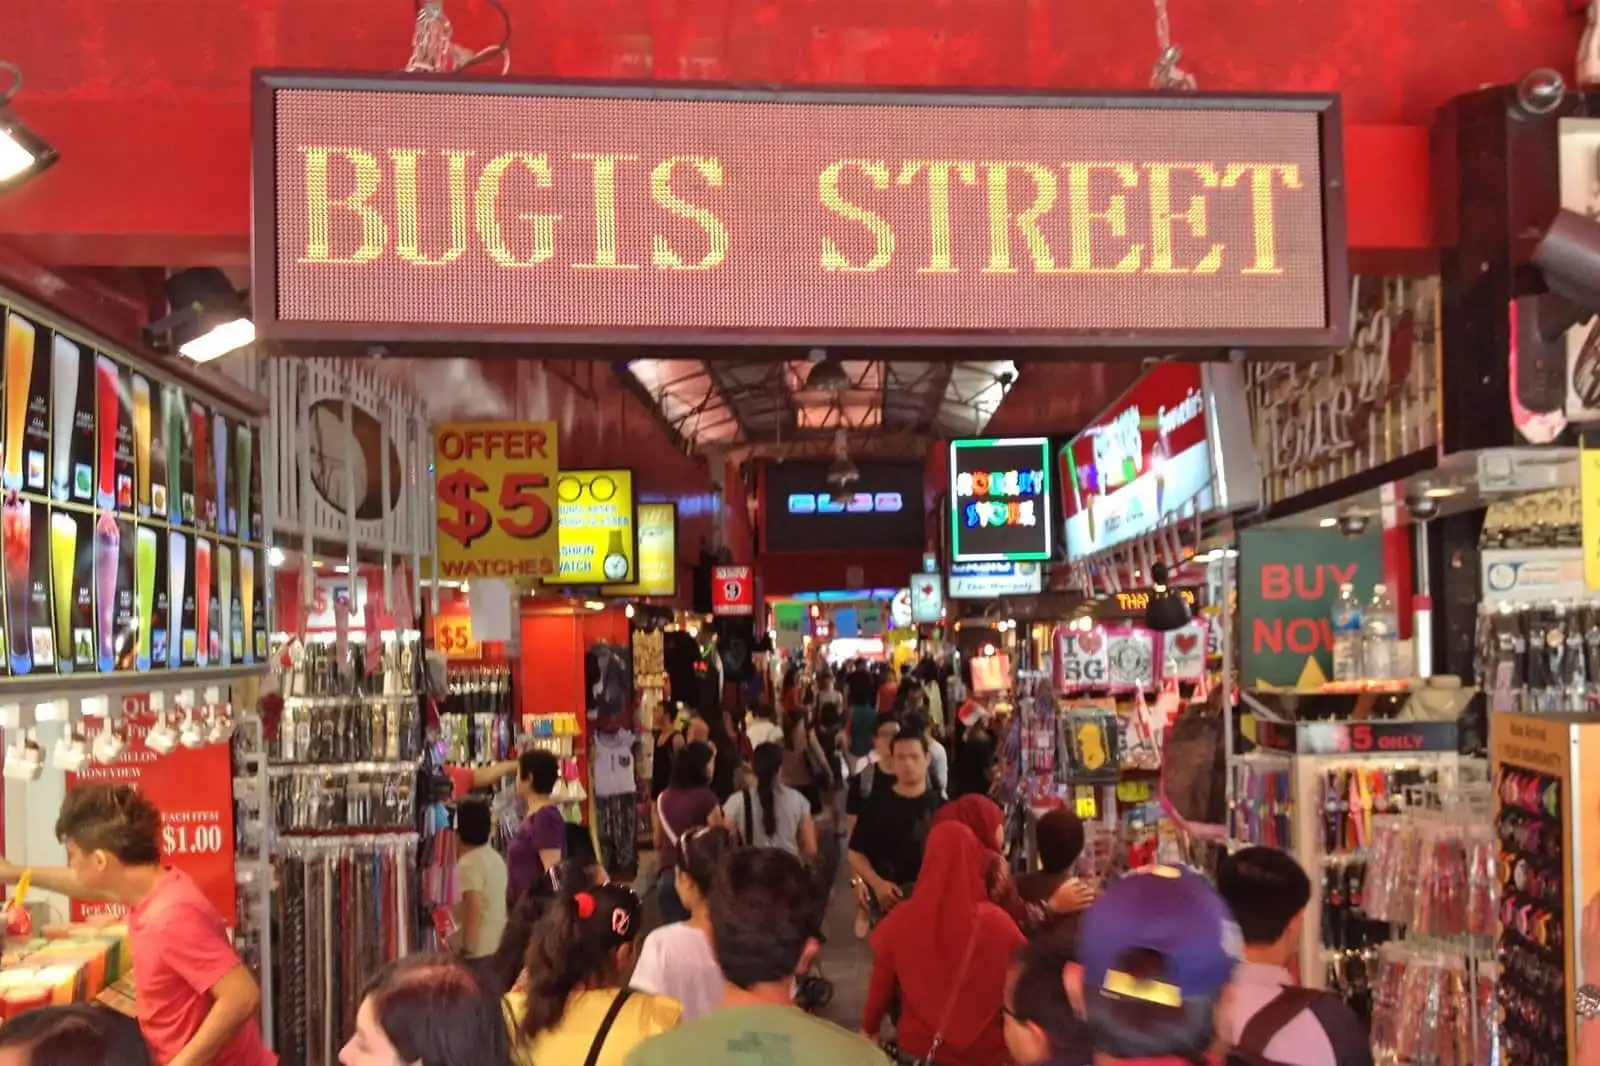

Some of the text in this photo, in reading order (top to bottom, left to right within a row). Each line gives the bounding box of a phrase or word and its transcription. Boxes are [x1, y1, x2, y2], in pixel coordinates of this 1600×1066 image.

[297, 146, 1303, 274] BUGIS STREET
[438, 429, 548, 461] OFFER
[436, 468, 552, 548] $5
[559, 545, 595, 557] SHION
[441, 557, 553, 577] WATCHES
[1260, 563, 1357, 600] BUY
[1116, 592, 1150, 610] THA
[439, 626, 468, 652] $5
[1064, 635, 1077, 657] I
[1064, 659, 1105, 681] SG
[1377, 735, 1425, 749] ONLY
[161, 811, 192, 822] EACH
[162, 825, 222, 856] $1.00
